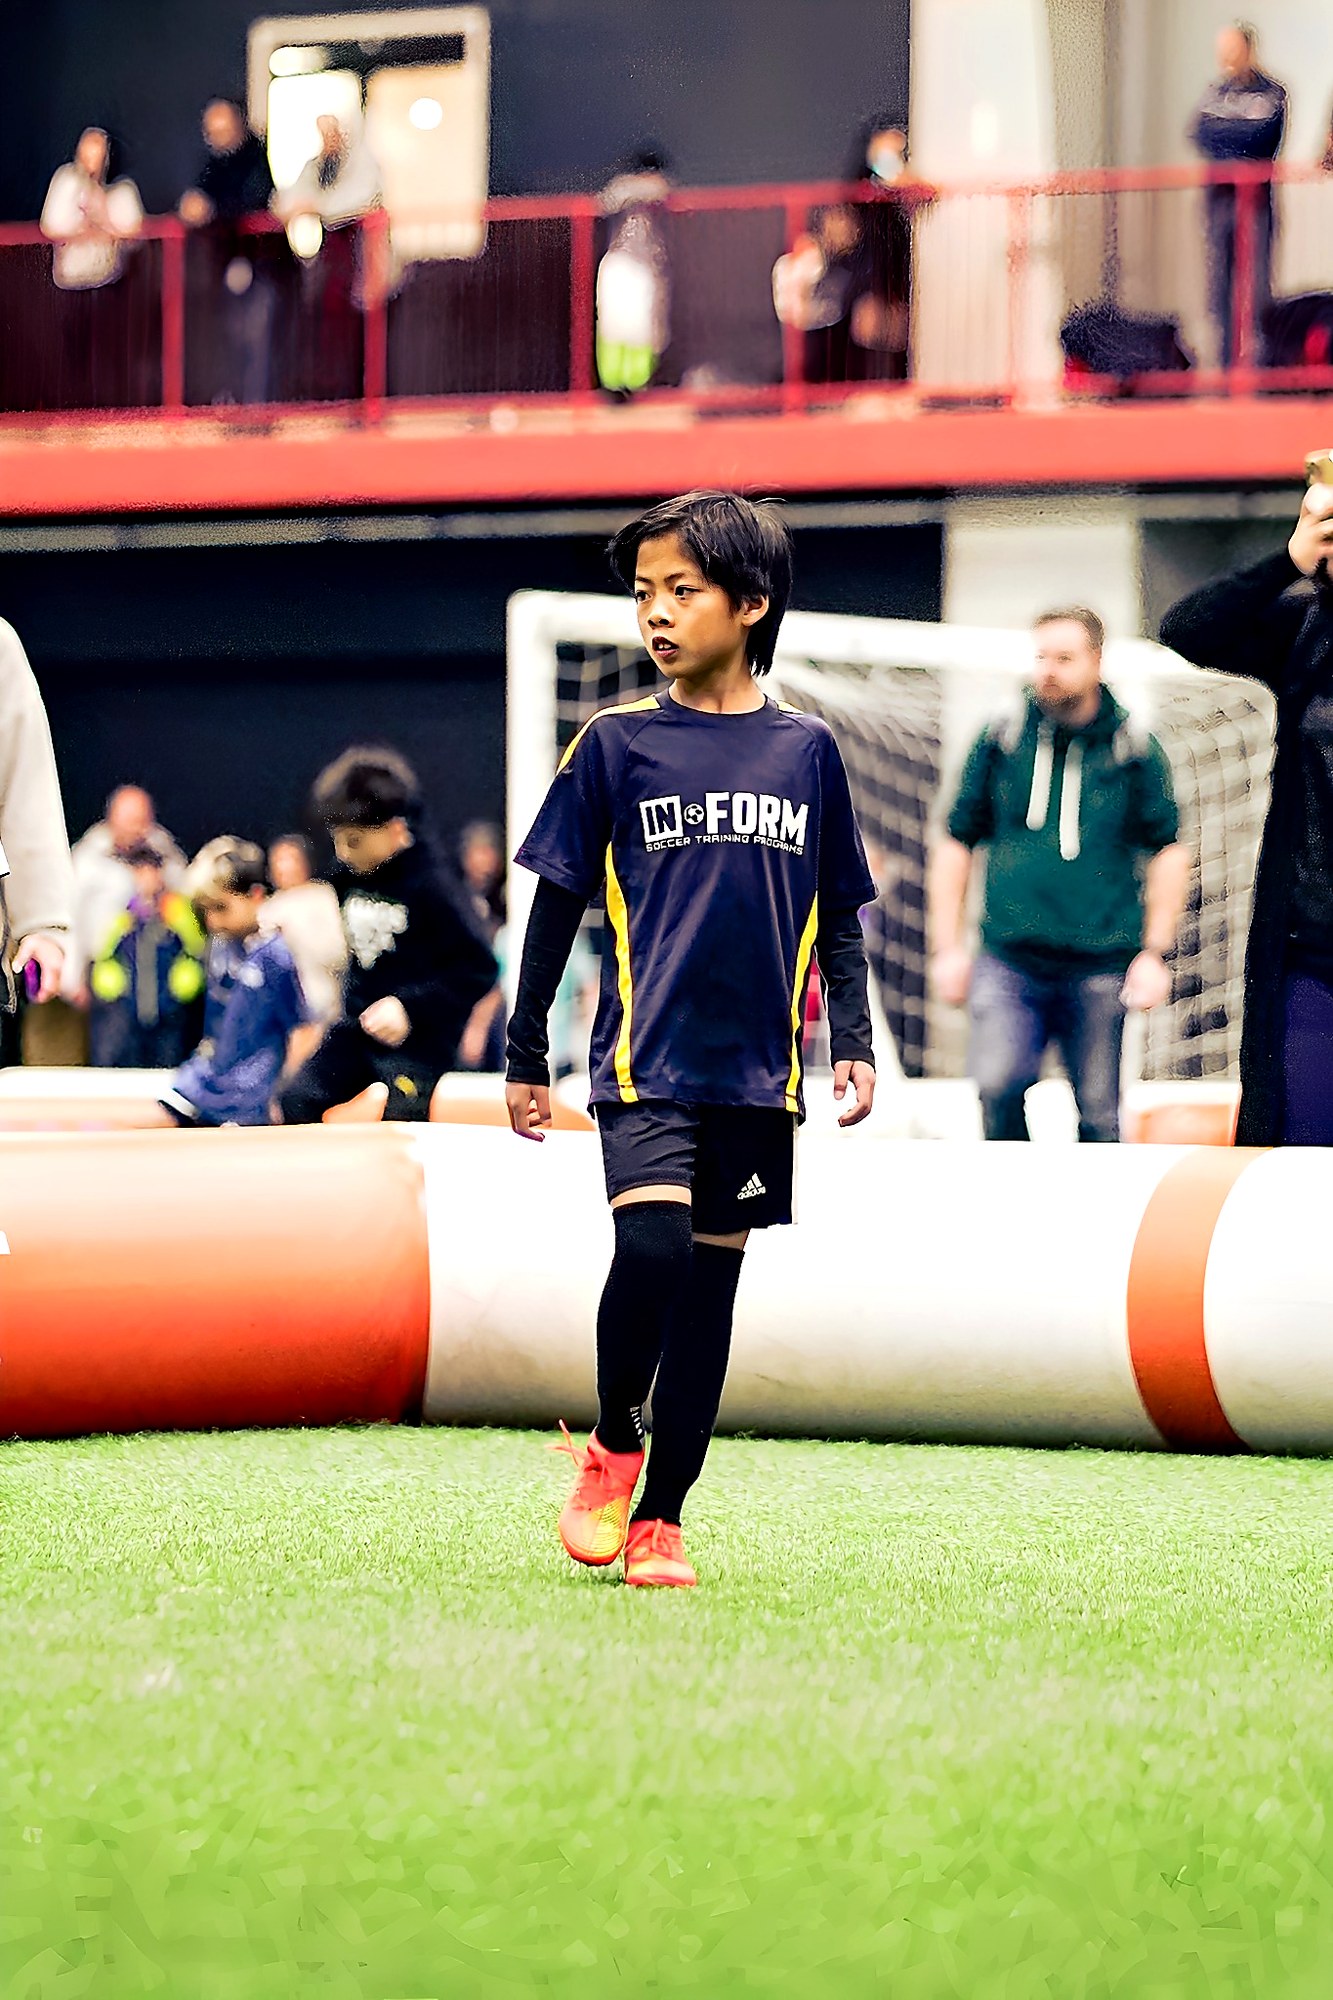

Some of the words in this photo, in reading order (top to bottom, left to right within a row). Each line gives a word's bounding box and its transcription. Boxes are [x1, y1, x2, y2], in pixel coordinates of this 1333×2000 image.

[642, 798, 682, 841] IN
[705, 791, 809, 846] FORM
[646, 836, 691, 852] SOCCER
[695, 834, 749, 844] TRAINING
[753, 835, 803, 856] PROGRAMS
